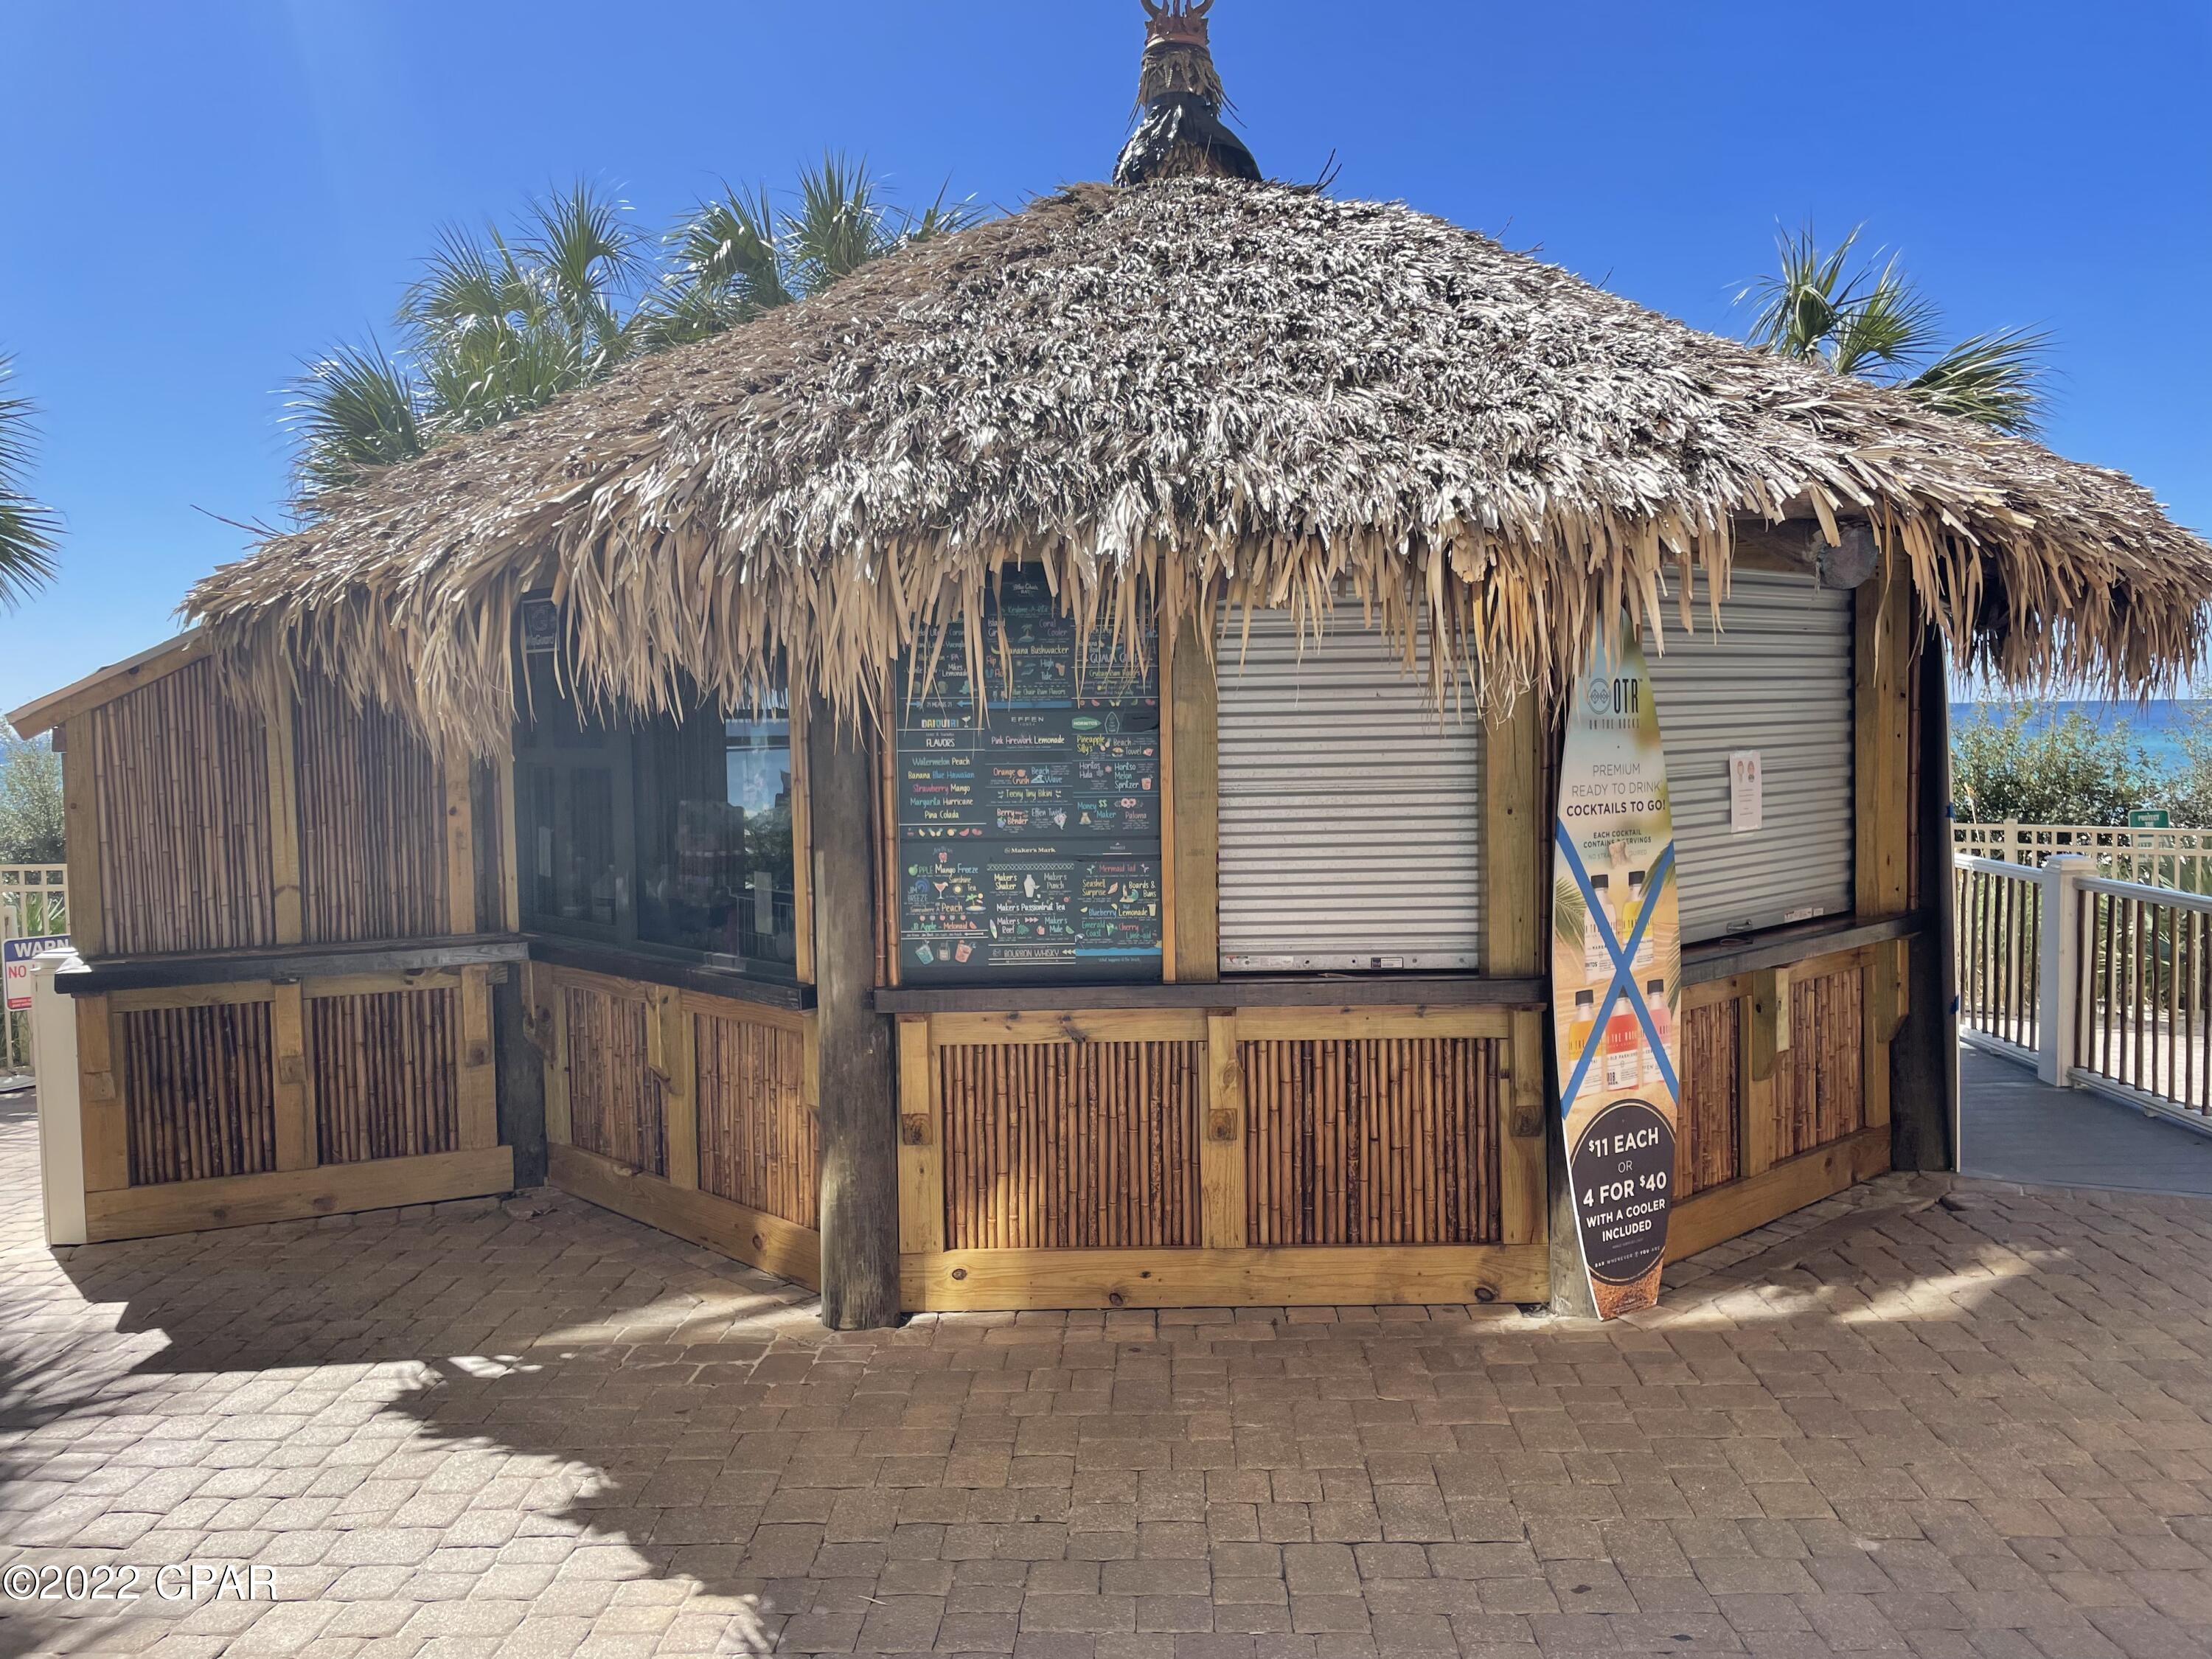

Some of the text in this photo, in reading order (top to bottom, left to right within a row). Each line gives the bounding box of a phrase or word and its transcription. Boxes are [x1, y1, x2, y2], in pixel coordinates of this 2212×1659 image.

[988, 617, 1006, 627] Islad
[1039, 619, 1056, 627] Coral
[1048, 627, 1068, 636] Cooler
[1031, 644, 1069, 655] Bushwacker
[1040, 658, 1054, 670] High
[942, 669, 968, 677] Lemonad
[1041, 672, 1052, 681] Tide
[1048, 687, 1066, 695] Flavors
[1613, 678, 1639, 714] OTR
[921, 719, 959, 728] DAIQUIRI
[1589, 717, 1640, 730] ON THE ROCKS
[926, 738, 955, 748] FLAVORS
[991, 734, 1065, 745] Pink Firework Lemonade
[1077, 734, 1105, 746] Pineapple
[1113, 737, 1132, 746] Beach
[1125, 746, 1142, 756] Towel
[912, 757, 970, 766] Watermelon Peach
[993, 768, 1015, 779] Orange
[1032, 765, 1050, 775] Beach
[1079, 770, 1093, 779] Hula
[1593, 762, 1641, 777] PREMIUM
[908, 771, 931, 779] Banana
[947, 771, 975, 779] Hawaiian
[1045, 776, 1062, 784] Wave
[1012, 776, 1030, 785] Crush
[913, 784, 970, 795] Strawberry Mango
[1115, 779, 1139, 793] Spritzer
[1571, 782, 1661, 797] READY TO DRINK
[1006, 788, 1053, 801] Teeny Tiny Bikini
[911, 797, 973, 808] Margarita Hurricane
[1077, 801, 1097, 813] Money
[997, 808, 1015, 818] Berry
[1032, 807, 1046, 817] Effen
[1566, 799, 1666, 817] COCKTAILS TO GO!
[940, 810, 959, 819] Colada
[1096, 810, 1116, 818] Maker
[1125, 811, 1147, 819] Paloma
[1007, 816, 1029, 825] Blender
[1593, 829, 1642, 839] EACH COCKTAIL
[1623, 836, 1652, 845] ERVINGS
[935, 863, 956, 876] Mango
[957, 863, 978, 874] Freeze
[1099, 863, 1125, 872] Mermaid
[949, 874, 972, 883] Sunshine
[994, 872, 1018, 882] Maker's
[995, 882, 1016, 890] Shaker
[1047, 881, 1064, 889] Punch
[1082, 879, 1105, 888] Seashell
[1129, 880, 1149, 888] Boards
[1082, 888, 1106, 898] Surprise
[941, 901, 963, 912] Peach
[996, 902, 1020, 911] Maker's
[1056, 902, 1065, 911] Tea
[1088, 906, 1147, 919] Blueberry Lemonade
[997, 917, 1020, 925] Maker's
[1082, 920, 1105, 929] Emerald
[920, 922, 937, 931] Apple
[1002, 925, 1015, 933] Reef
[1049, 925, 1062, 933] Mule
[1119, 922, 1138, 931] Cherry
[1086, 929, 1102, 937] Coast
[14, 939, 69, 958] WARN
[8, 965, 27, 978] NO
[1588, 1127, 1659, 1158] $11 EACH
[1618, 1160, 1633, 1173] OR
[1583, 1171, 1667, 1208] 4 FOR $40
[1586, 1198, 1666, 1229] WITH A COOLER
[1601, 1220, 1652, 1242] INCLUDED
[1607, 1253, 1632, 1265] WHEREVER
